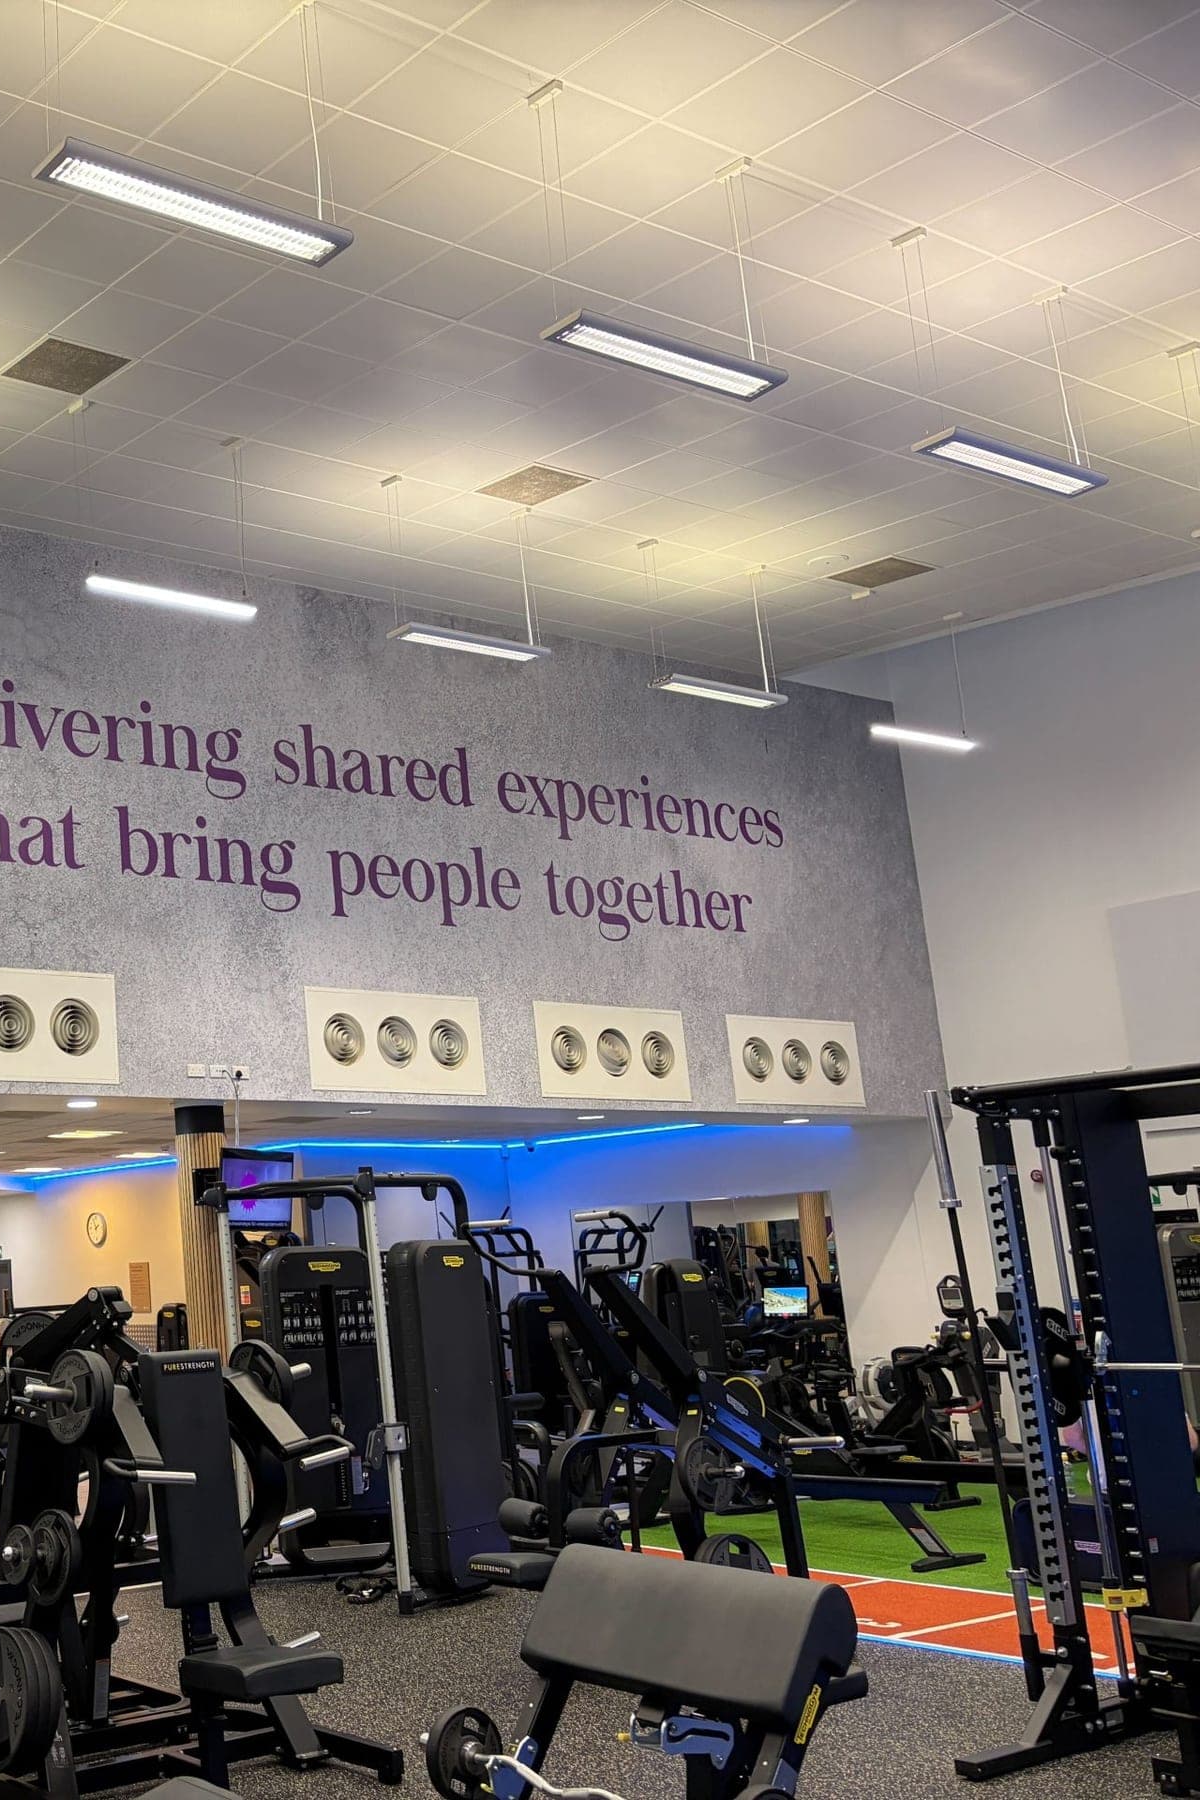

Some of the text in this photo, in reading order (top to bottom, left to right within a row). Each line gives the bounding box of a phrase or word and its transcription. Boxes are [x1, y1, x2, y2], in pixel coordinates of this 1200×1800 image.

[273, 724, 474, 807] shared
[498, 762, 784, 848] experiences
[119, 804, 302, 912] bring
[328, 847, 521, 931] people
[543, 861, 753, 941] together
[163, 1360, 215, 1371] PURESTRENGTH
